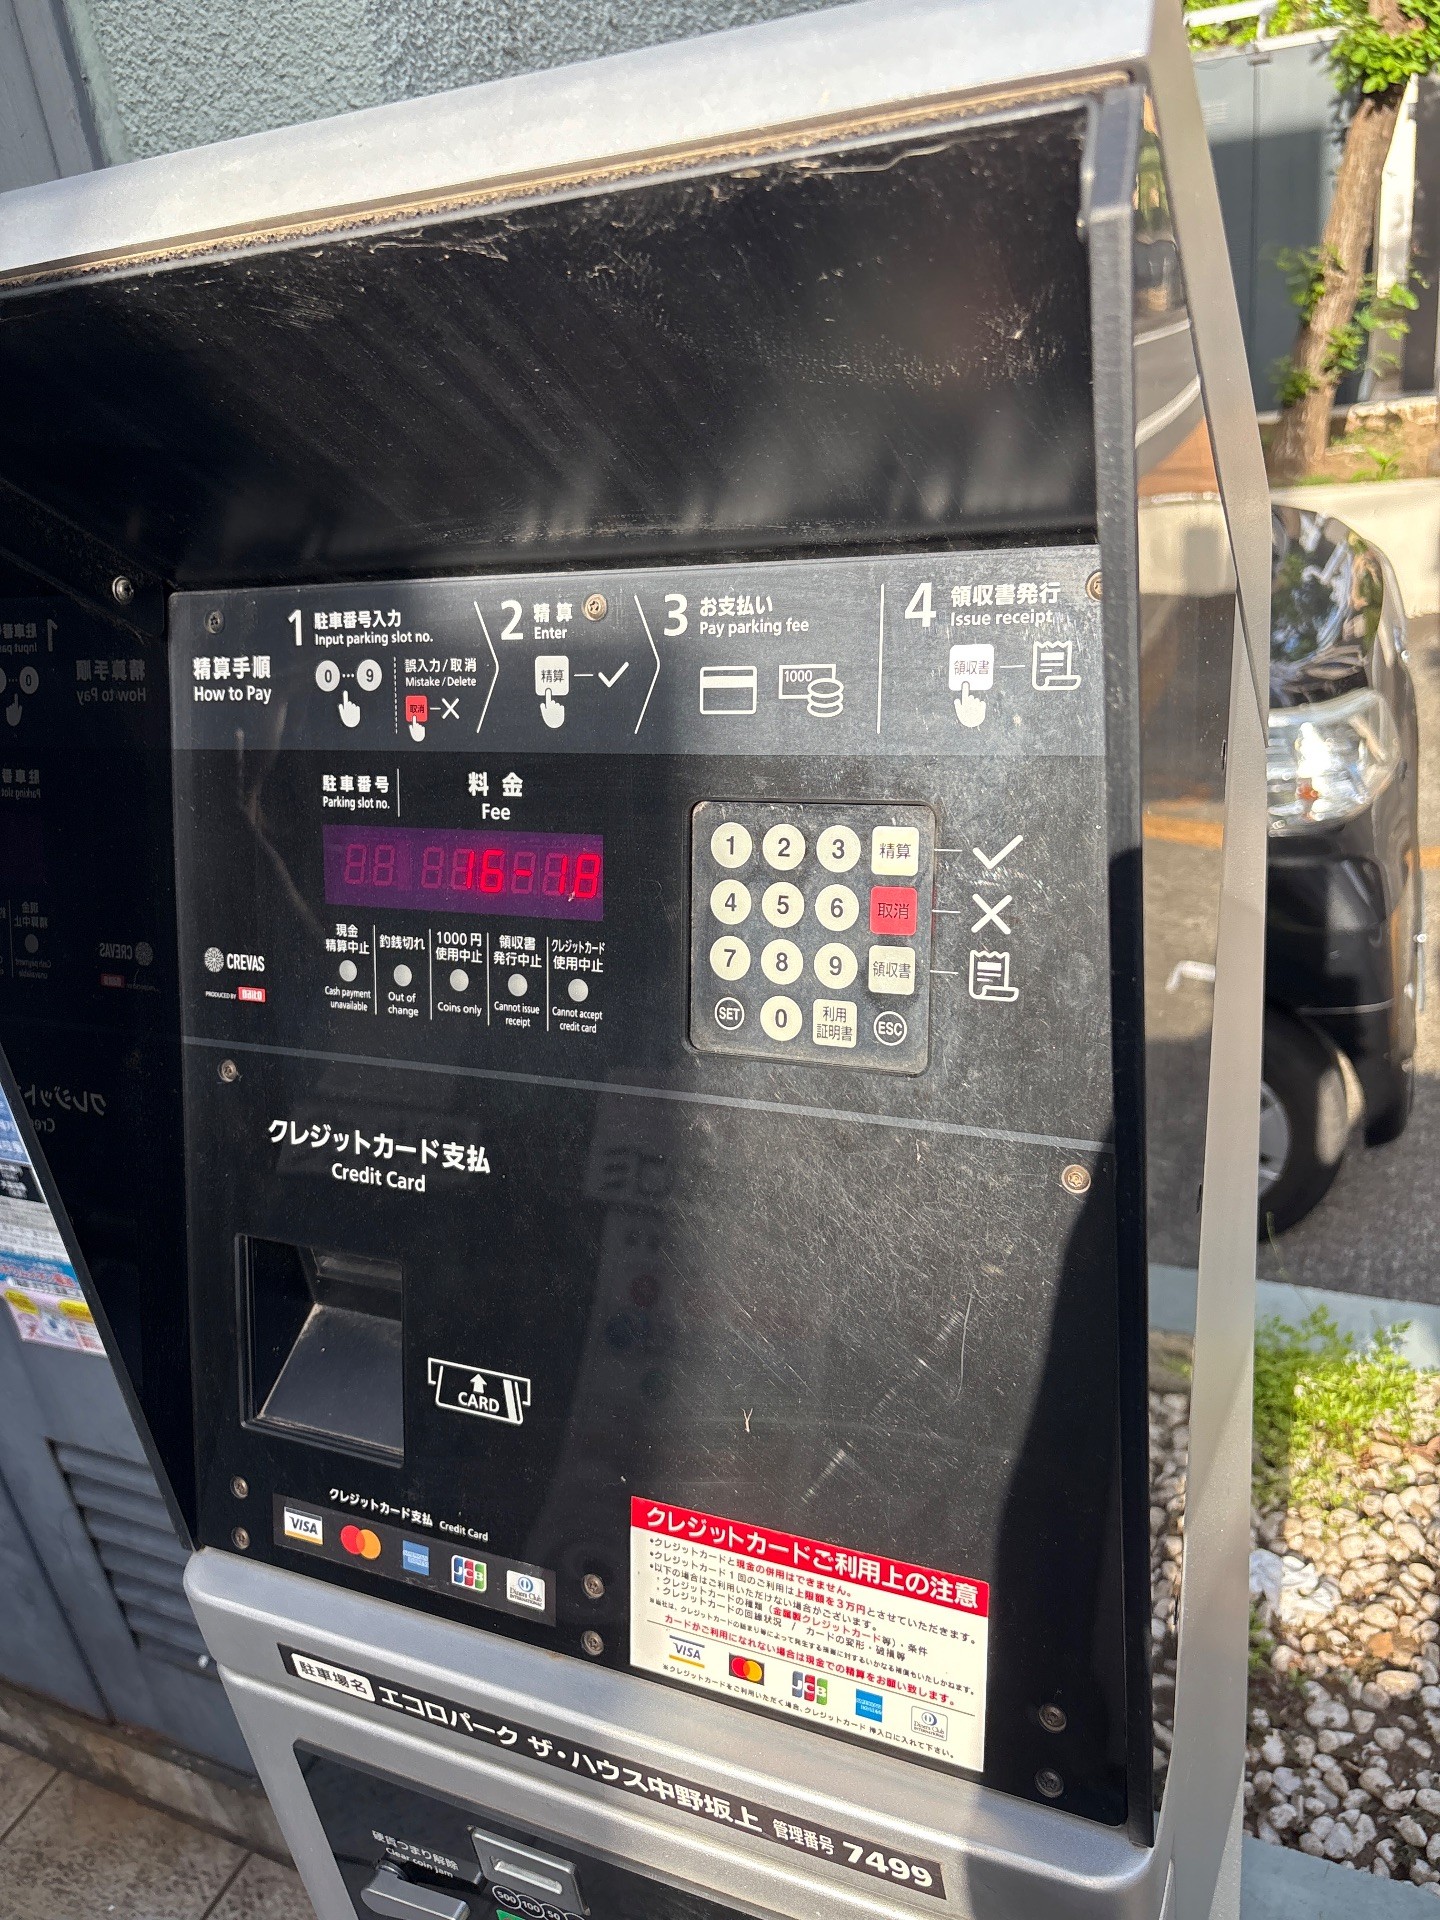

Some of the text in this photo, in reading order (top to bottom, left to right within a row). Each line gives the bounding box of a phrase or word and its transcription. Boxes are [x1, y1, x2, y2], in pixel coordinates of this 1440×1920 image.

[950, 581, 1060, 608] 領収書発行
[533, 602, 572, 623] 精算
[700, 595, 773, 617] お支払い
[904, 582, 936, 628] 4
[314, 609, 401, 630] 駐車番号入力
[501, 599, 524, 640] 2
[663, 593, 688, 636] 3
[951, 609, 1053, 628] Issue receipt
[288, 609, 303, 646] 1
[534, 626, 567, 640] Enter
[700, 617, 809, 638] Pay parking fee
[315, 631, 434, 648] Input parking slot no.
[193, 656, 271, 680] 精算手順
[324, 668, 374, 683] 0 9
[541, 669, 565, 683] 精算
[784, 668, 813, 683] 1000
[954, 660, 990, 675] 領収書
[194, 686, 271, 704] How to Pay
[410, 704, 425, 714] 取消
[322, 774, 390, 793] 駐車番号
[468, 771, 524, 797] 料金
[322, 796, 390, 811] Parking slot no.
[482, 803, 511, 821] Fee
[726, 836, 734, 855] 1
[777, 837, 791, 857] 2
[832, 838, 845, 859] 3
[880, 842, 911, 860] 精算
[724, 892, 737, 911] 4
[777, 895, 789, 914] 5
[830, 898, 844, 918] 6
[878, 902, 910, 920] 取消
[336, 923, 358, 938] 現金
[325, 938, 370, 955] 精算中止
[379, 934, 425, 950] 釣銭切れ
[499, 935, 536, 950] 領収書
[551, 939, 605, 955] クレジットカード
[226, 953, 265, 972] CREVAS
[436, 947, 483, 964] 使用中止
[493, 951, 542, 968] 発行中止
[553, 955, 604, 973] 使用中止
[724, 949, 736, 967] 7
[775, 952, 788, 971] 8
[829, 956, 842, 975] 9
[873, 961, 911, 979] 領収書
[324, 985, 371, 999] Cash payment
[388, 991, 416, 1003] Out of
[330, 1001, 368, 1012] unavailable
[387, 1004, 419, 1018] change
[437, 1002, 482, 1017] Coins only
[494, 1001, 540, 1015] Cannot issue
[552, 1006, 603, 1021] Cannot accept
[718, 1007, 740, 1021] SET
[823, 1005, 847, 1022] 利用
[505, 1016, 531, 1028] receipt
[775, 1008, 788, 1028] 0
[559, 1022, 597, 1033] credit card
[817, 1023, 853, 1041] 証明書
[877, 1022, 903, 1036] ESC
[268, 1119, 491, 1174] クレジットカード支払
[331, 1162, 426, 1193] Credit Card
[458, 1391, 500, 1413] CARD
[329, 1488, 489, 1541] クレジットカード支払 Credit Card
[289, 1515, 318, 1535] VISA
[647, 1506, 979, 1609] クレジットカードご利用上の注意
[453, 1566, 484, 1582] JCB
[674, 1643, 701, 1660] VISA
[792, 1679, 827, 1697] JCB
[299, 1660, 933, 1887] 駐車場名 エコロパーク ザ・ハウス中野坂上 管理番号 7499
[371, 1829, 459, 1871] 硬貨つまり解除
[386, 1847, 454, 1878] Clear coin jam
[497, 1890, 517, 1904] 500
[522, 1900, 541, 1913] 100
